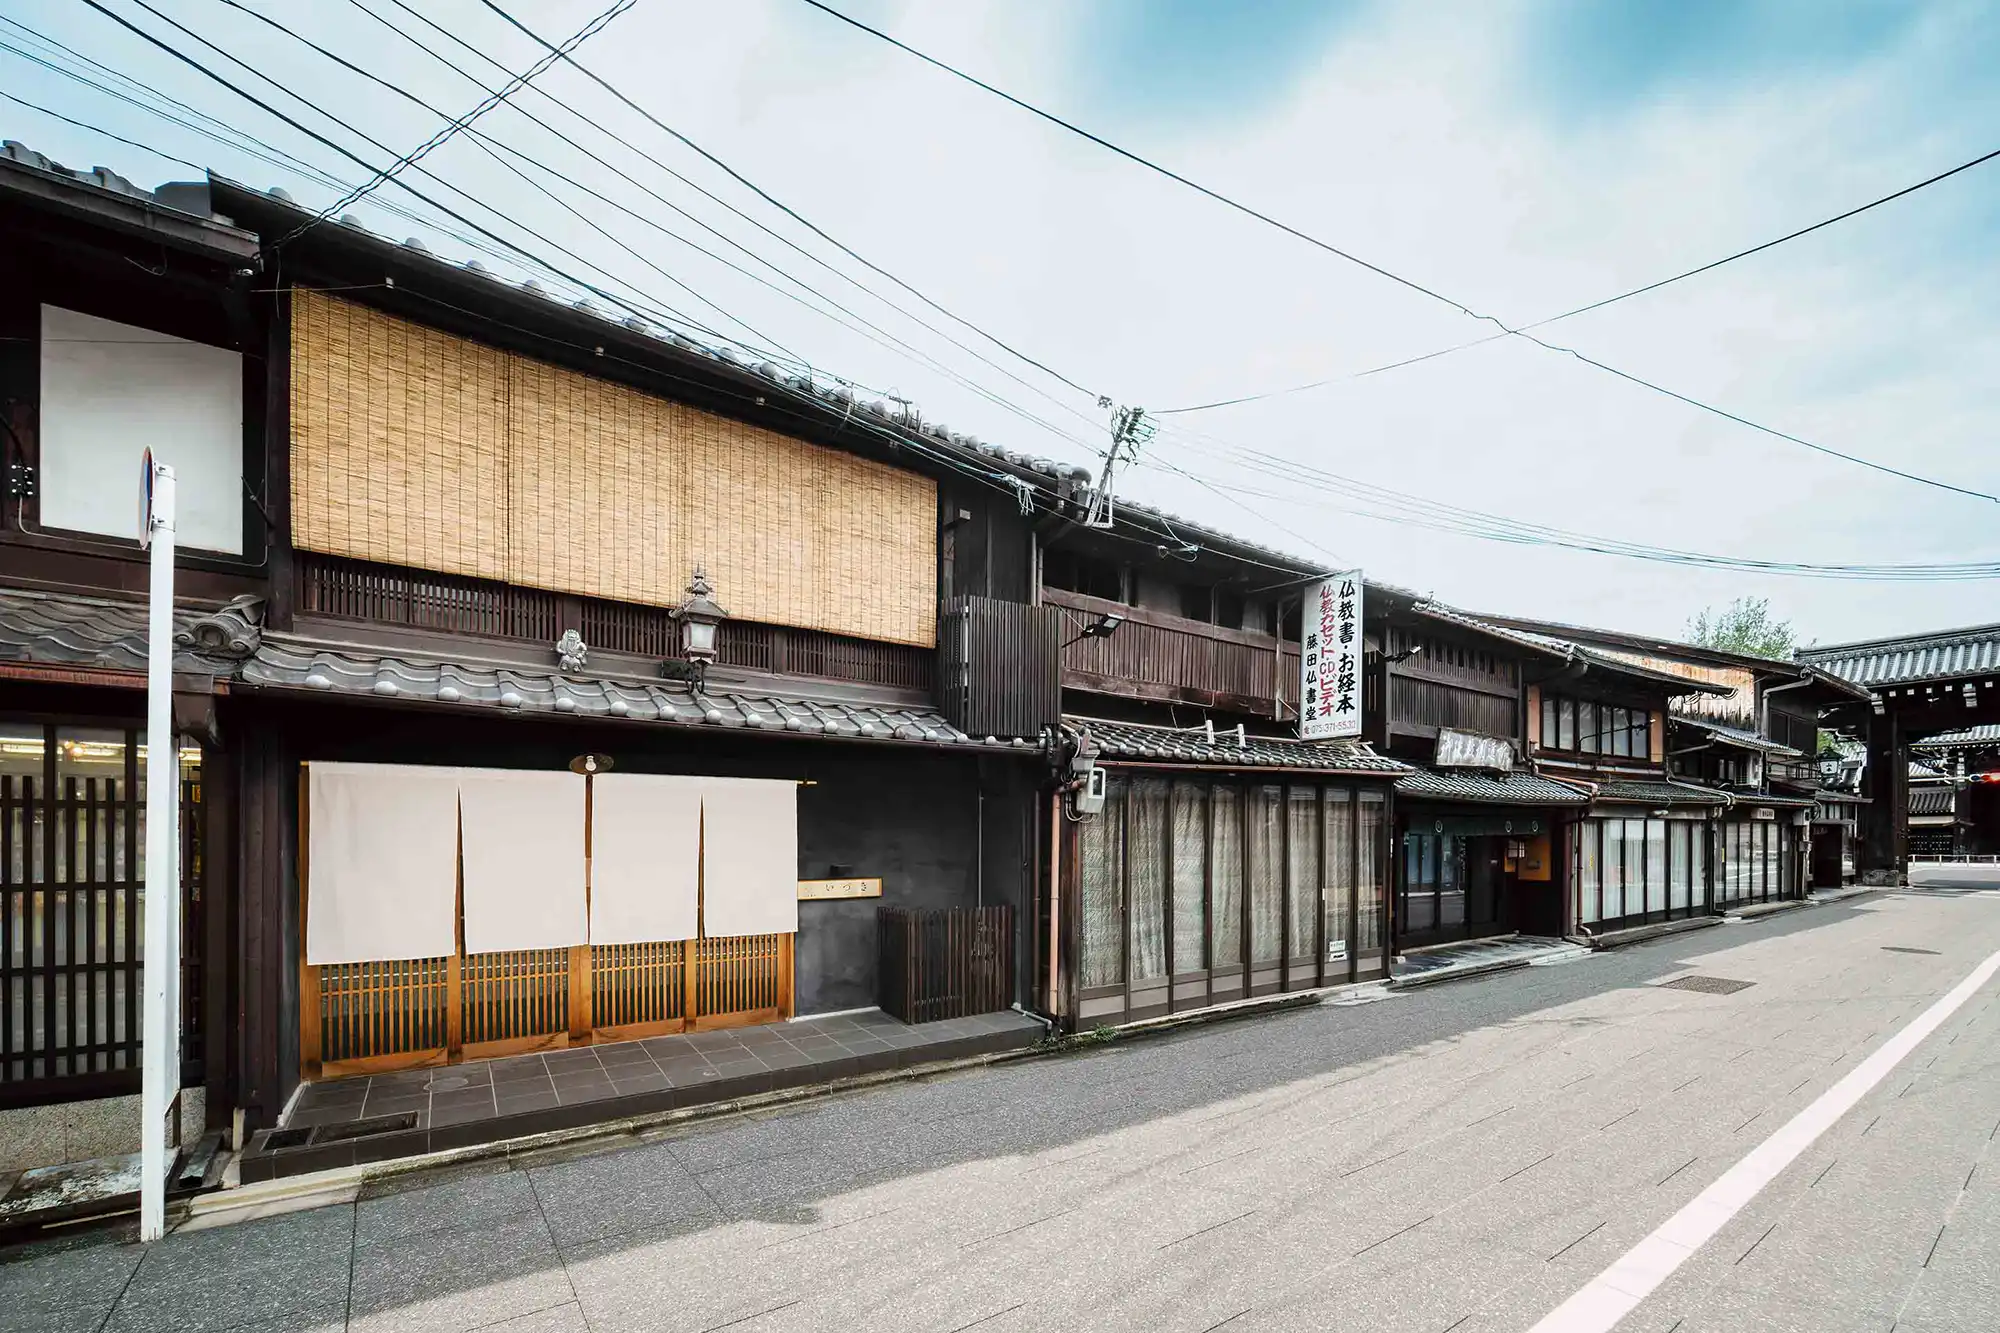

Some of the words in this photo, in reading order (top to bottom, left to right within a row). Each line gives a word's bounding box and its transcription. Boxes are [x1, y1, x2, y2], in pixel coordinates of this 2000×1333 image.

[1305, 633, 1318, 722] 藤田仏書堂
[1336, 579, 1355, 715] 仏教書・お経本
